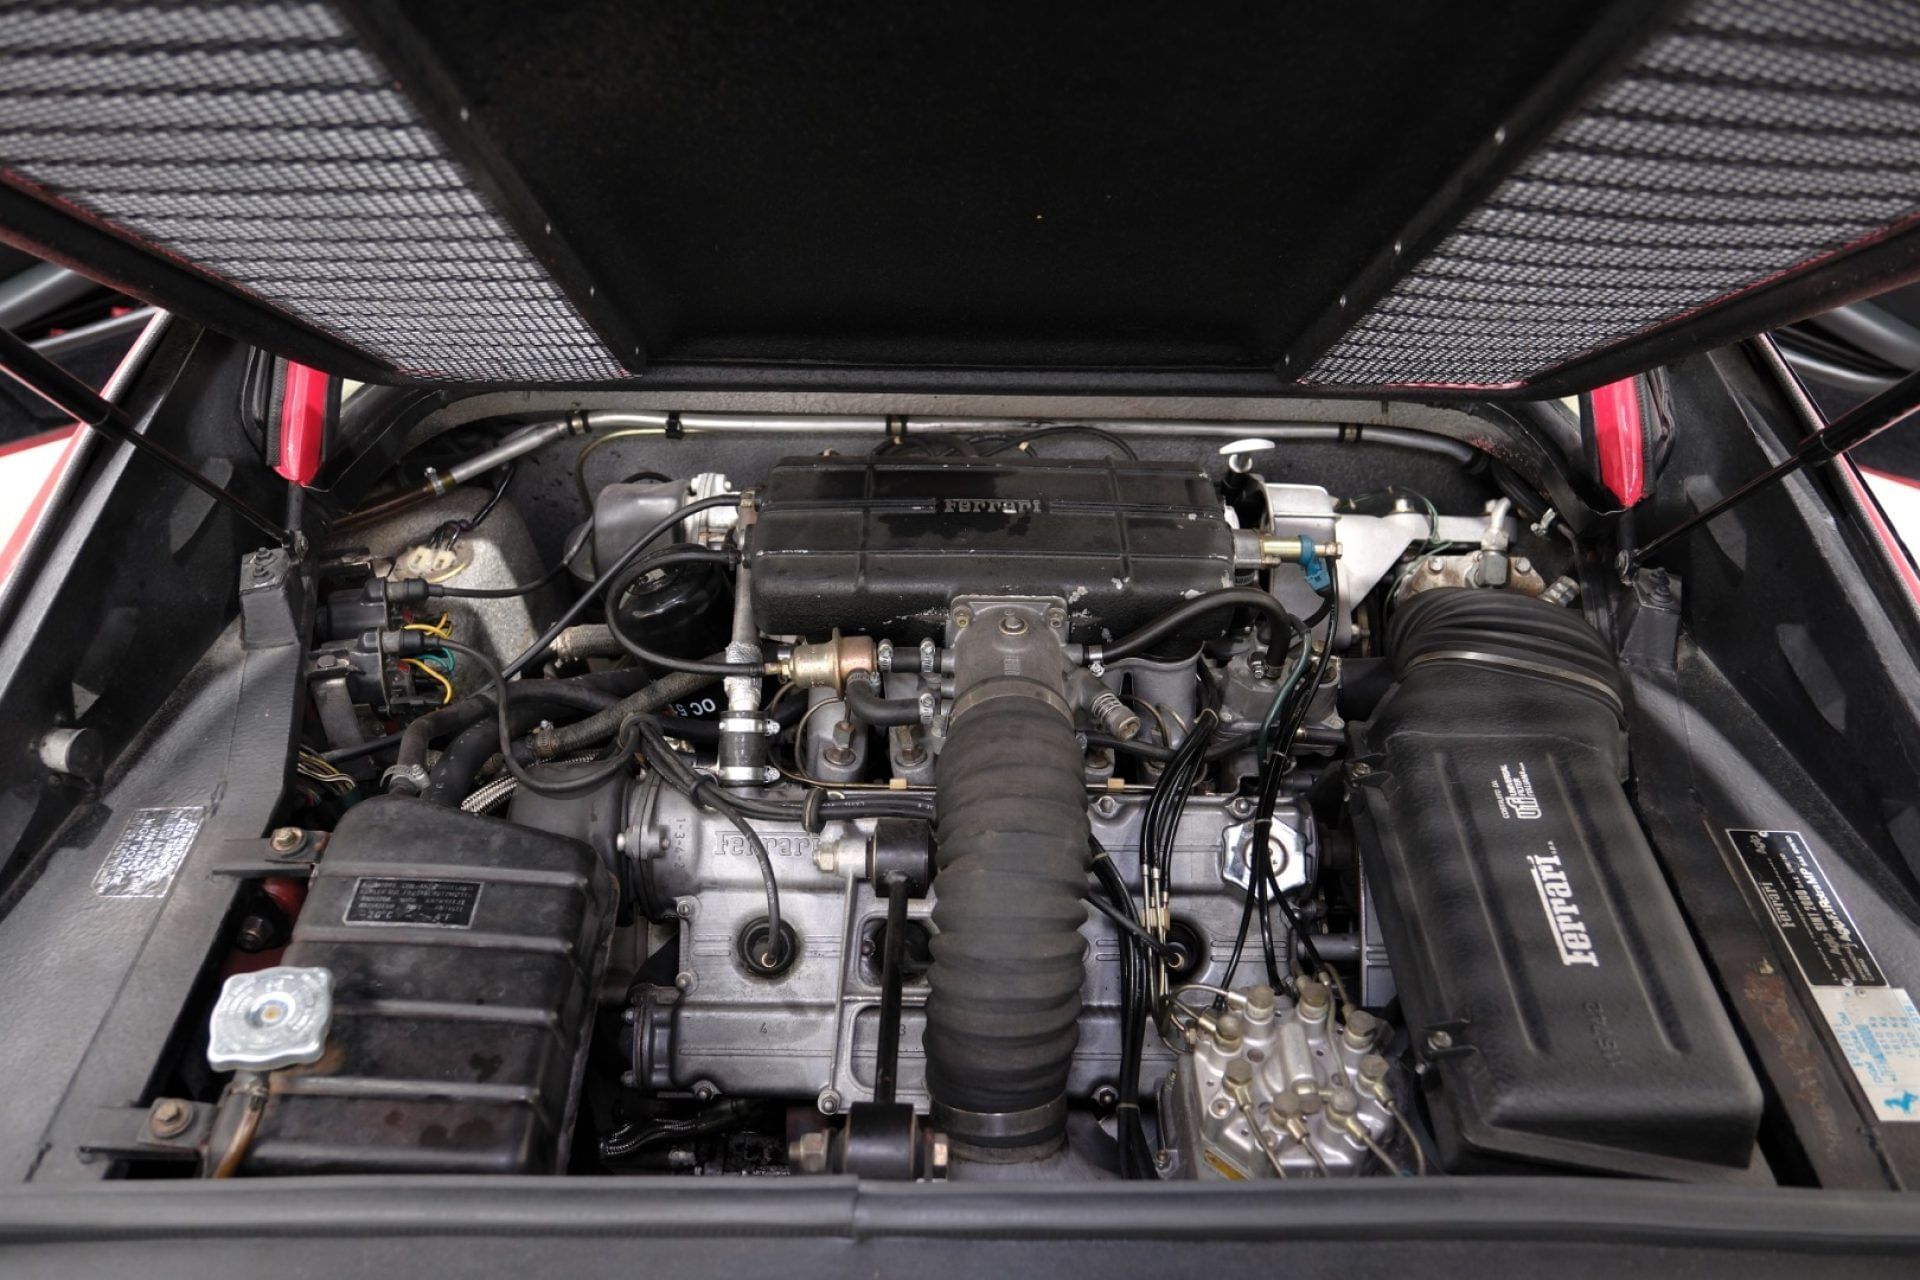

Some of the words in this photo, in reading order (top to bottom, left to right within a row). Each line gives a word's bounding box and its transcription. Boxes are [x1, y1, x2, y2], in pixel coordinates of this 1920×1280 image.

[944, 498, 1042, 514] Ferrari
[689, 698, 716, 715] OC
[1799, 867, 1816, 882] MP
[1758, 882, 1796, 927] Ferrari
[1794, 889, 1817, 910] 2000
[1526, 855, 1599, 967] Ferrari
[1807, 912, 1828, 931] SINT
[1833, 920, 1852, 942] Agip
[759, 1021, 768, 1034] 4
